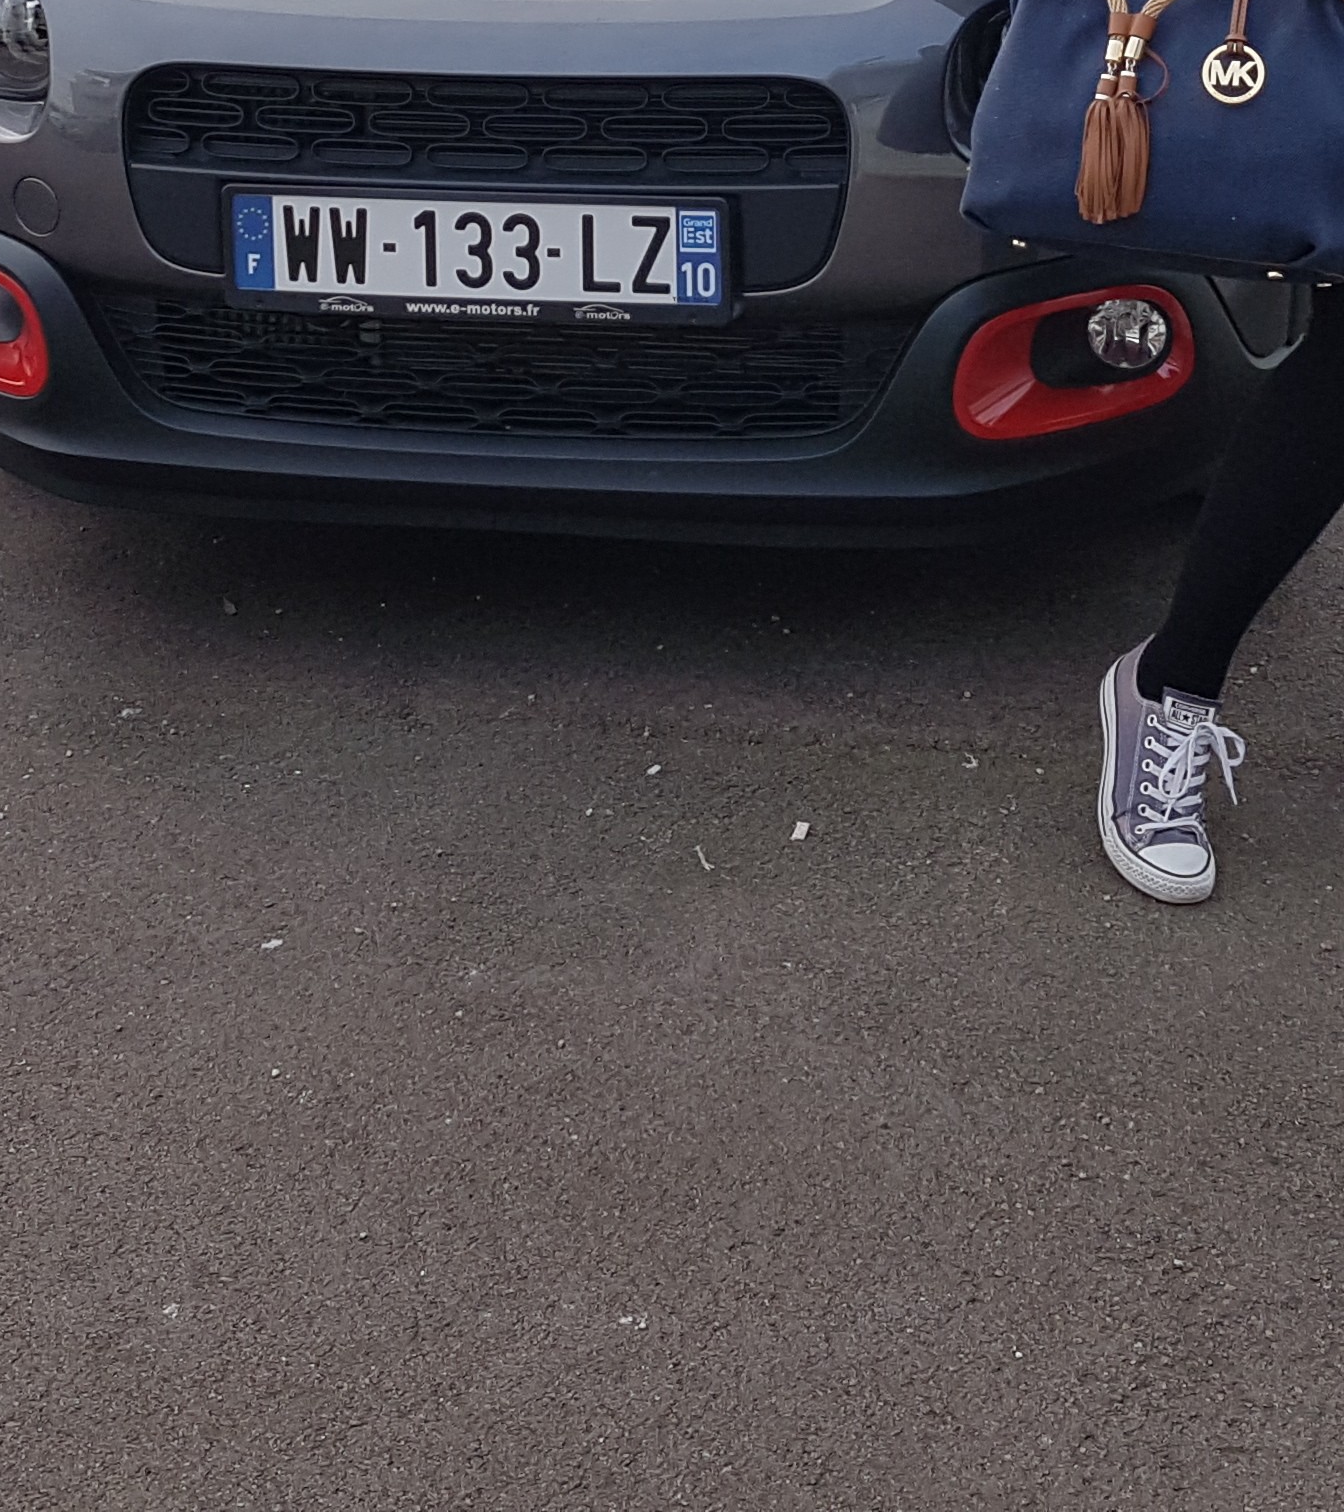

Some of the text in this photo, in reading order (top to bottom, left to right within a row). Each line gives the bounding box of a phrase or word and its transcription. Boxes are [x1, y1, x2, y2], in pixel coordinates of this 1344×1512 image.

[1210, 59, 1258, 87] MK
[682, 218, 713, 228] Grand
[682, 227, 713, 244] Est
[282, 204, 671, 295] WW-133-LZ
[247, 253, 261, 275] F
[681, 262, 716, 297] 10
[405, 301, 541, 316] www.e-motors.fr
